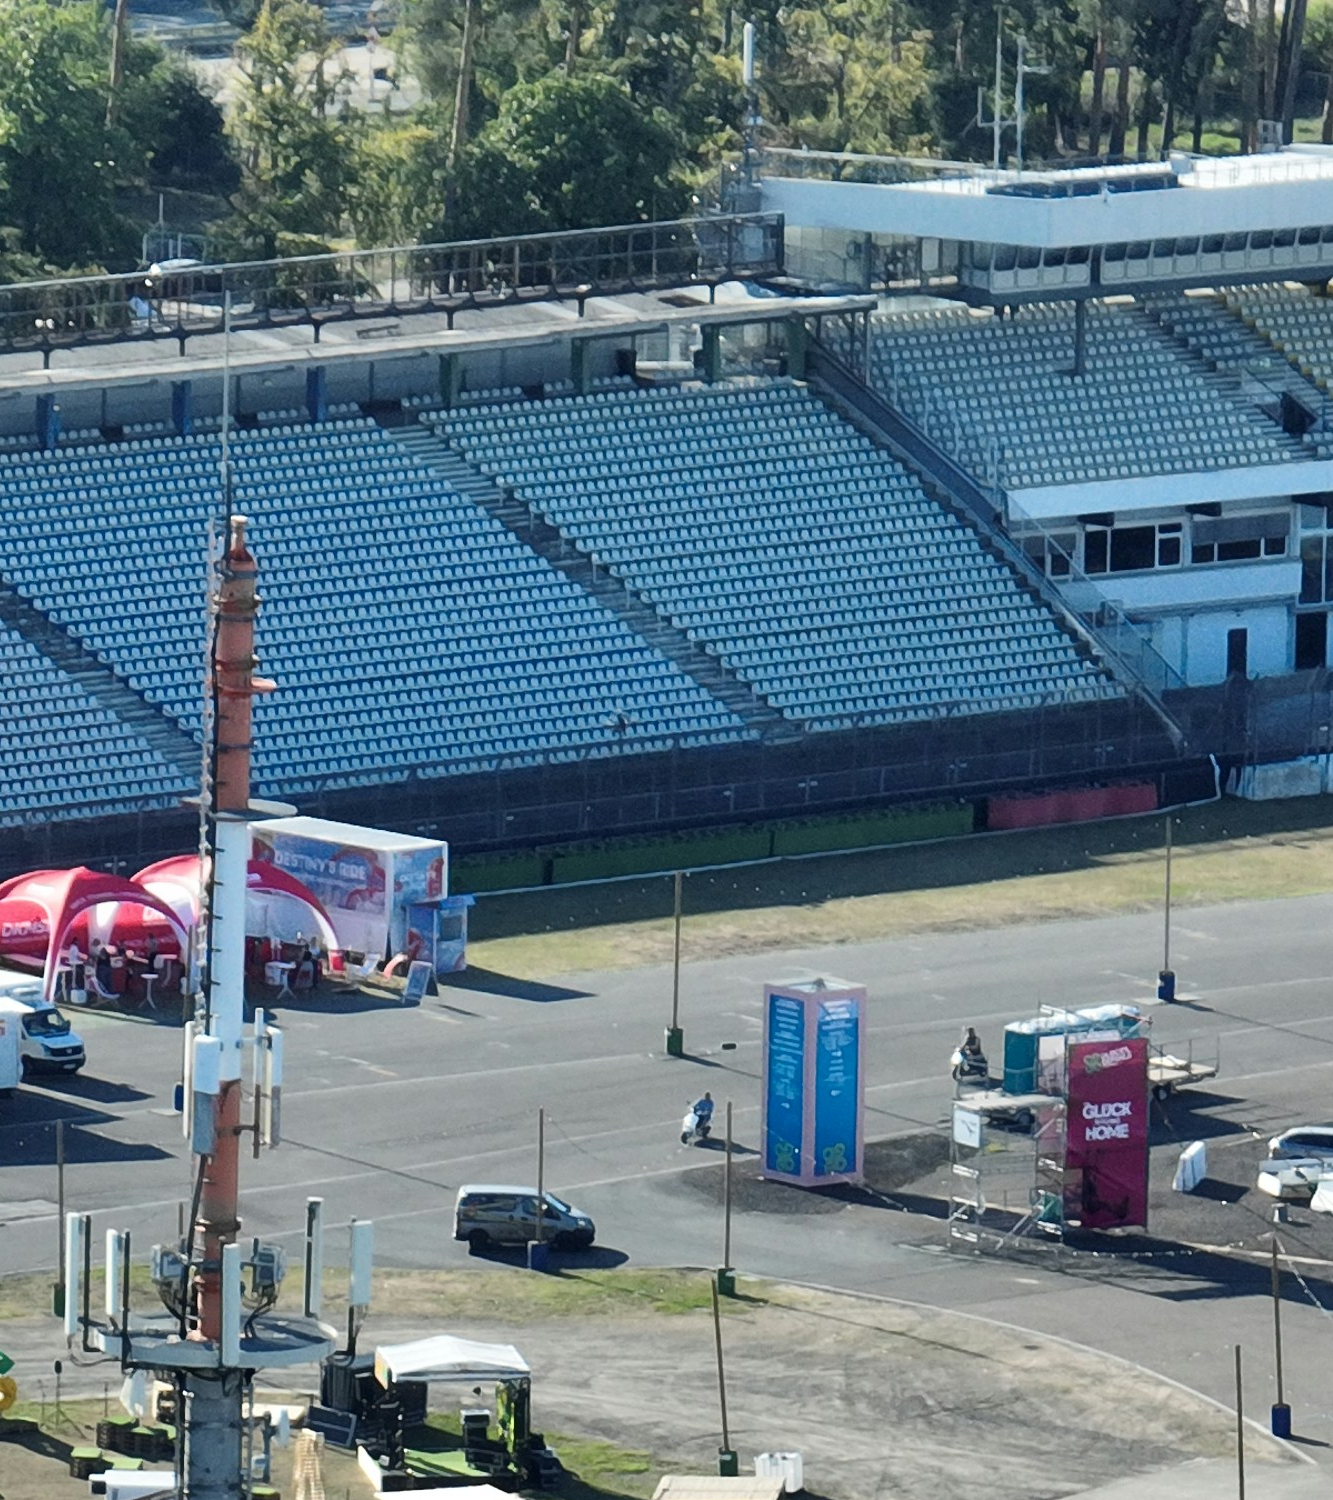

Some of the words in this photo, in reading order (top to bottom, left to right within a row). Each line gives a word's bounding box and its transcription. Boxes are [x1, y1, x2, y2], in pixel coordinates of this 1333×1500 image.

[274, 850, 336, 876] DESTINY'S
[339, 863, 367, 881] RIDE
[1085, 1123, 1129, 1141] HOME
